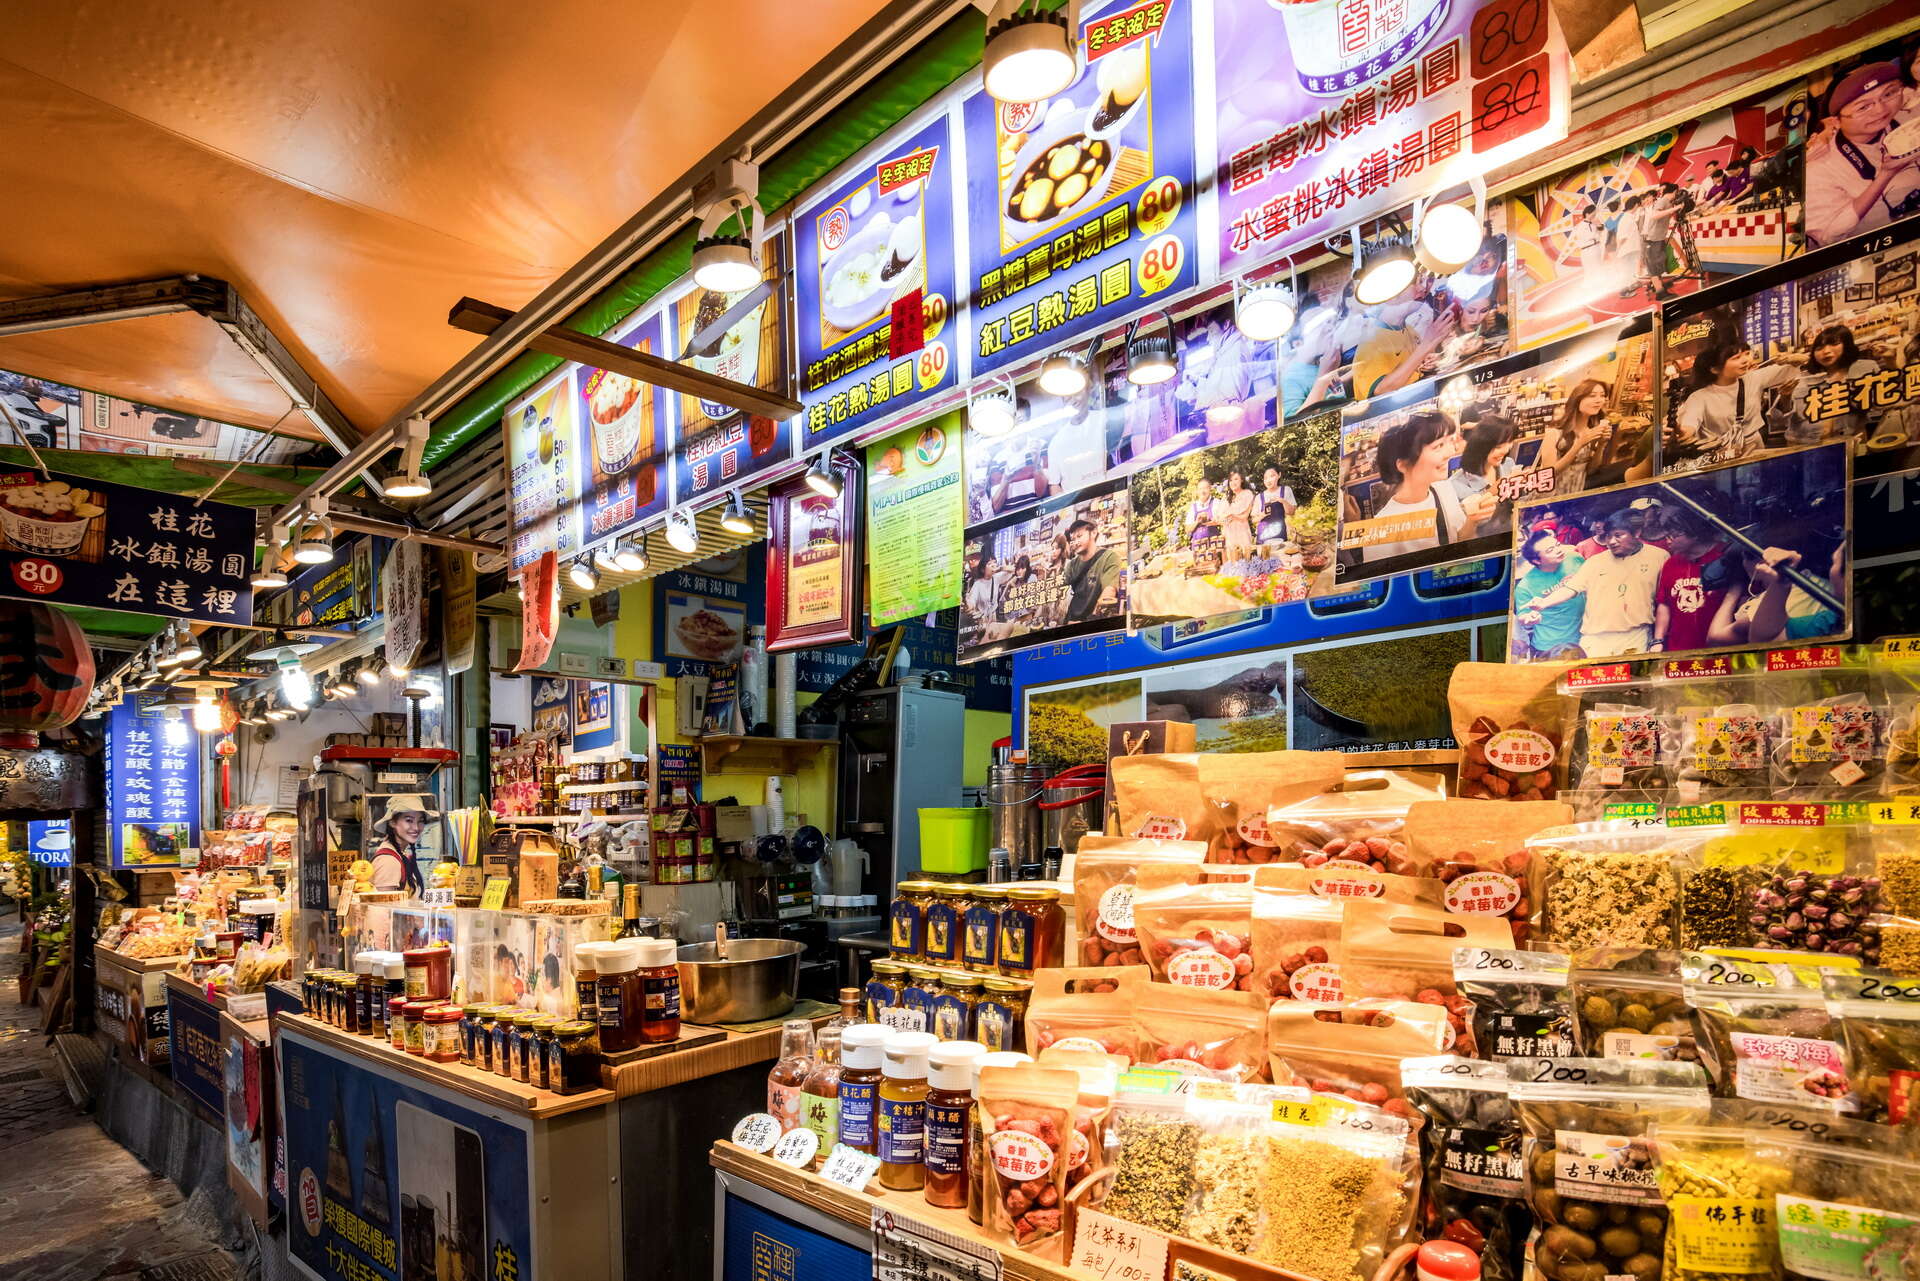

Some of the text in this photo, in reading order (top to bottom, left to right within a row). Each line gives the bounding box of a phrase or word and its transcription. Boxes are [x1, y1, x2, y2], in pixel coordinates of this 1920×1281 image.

[1090, 4, 1165, 50] 冬季限定
[1231, 39, 1461, 191] 藍莓冰鎮湯圓
[1479, 0, 1540, 65] 80
[880, 152, 932, 187] 冬季限定
[1231, 110, 1461, 251] 水蜜桃冰鎮湯圓
[1142, 181, 1177, 222] 80
[1153, 220, 1165, 233] 元
[1863, 236, 1893, 252] 1/3
[980, 240, 1178, 357] 紅豆熱湯圓 80 元
[807, 345, 944, 434] 桂花熱湯圓 80 元
[1474, 371, 1494, 382] 1/3
[1498, 467, 1554, 503] 好喝
[149, 506, 216, 539] 桂花
[109, 536, 246, 580] 冰鎮湯圓
[20, 561, 58, 585] 80
[677, 574, 737, 598] 冰鎮湯圓
[33, 583, 45, 592] 元
[107, 571, 237, 615] 在這裡
[1770, 648, 1837, 662] 玫瑰花
[1743, 806, 1820, 819] 玫瑰花
[32, 851, 70, 864] TORA
[1742, 1037, 1832, 1064] 玫瑰梅
[842, 1087, 872, 1099] 桂花醋
[810, 1102, 829, 1123] 梅
[892, 1104, 925, 1116] 金桔汁
[1278, 1104, 1311, 1122] 桂花
[1786, 1203, 1888, 1233] 綠茶梅
[1081, 1221, 1142, 1259] 花茶系列
